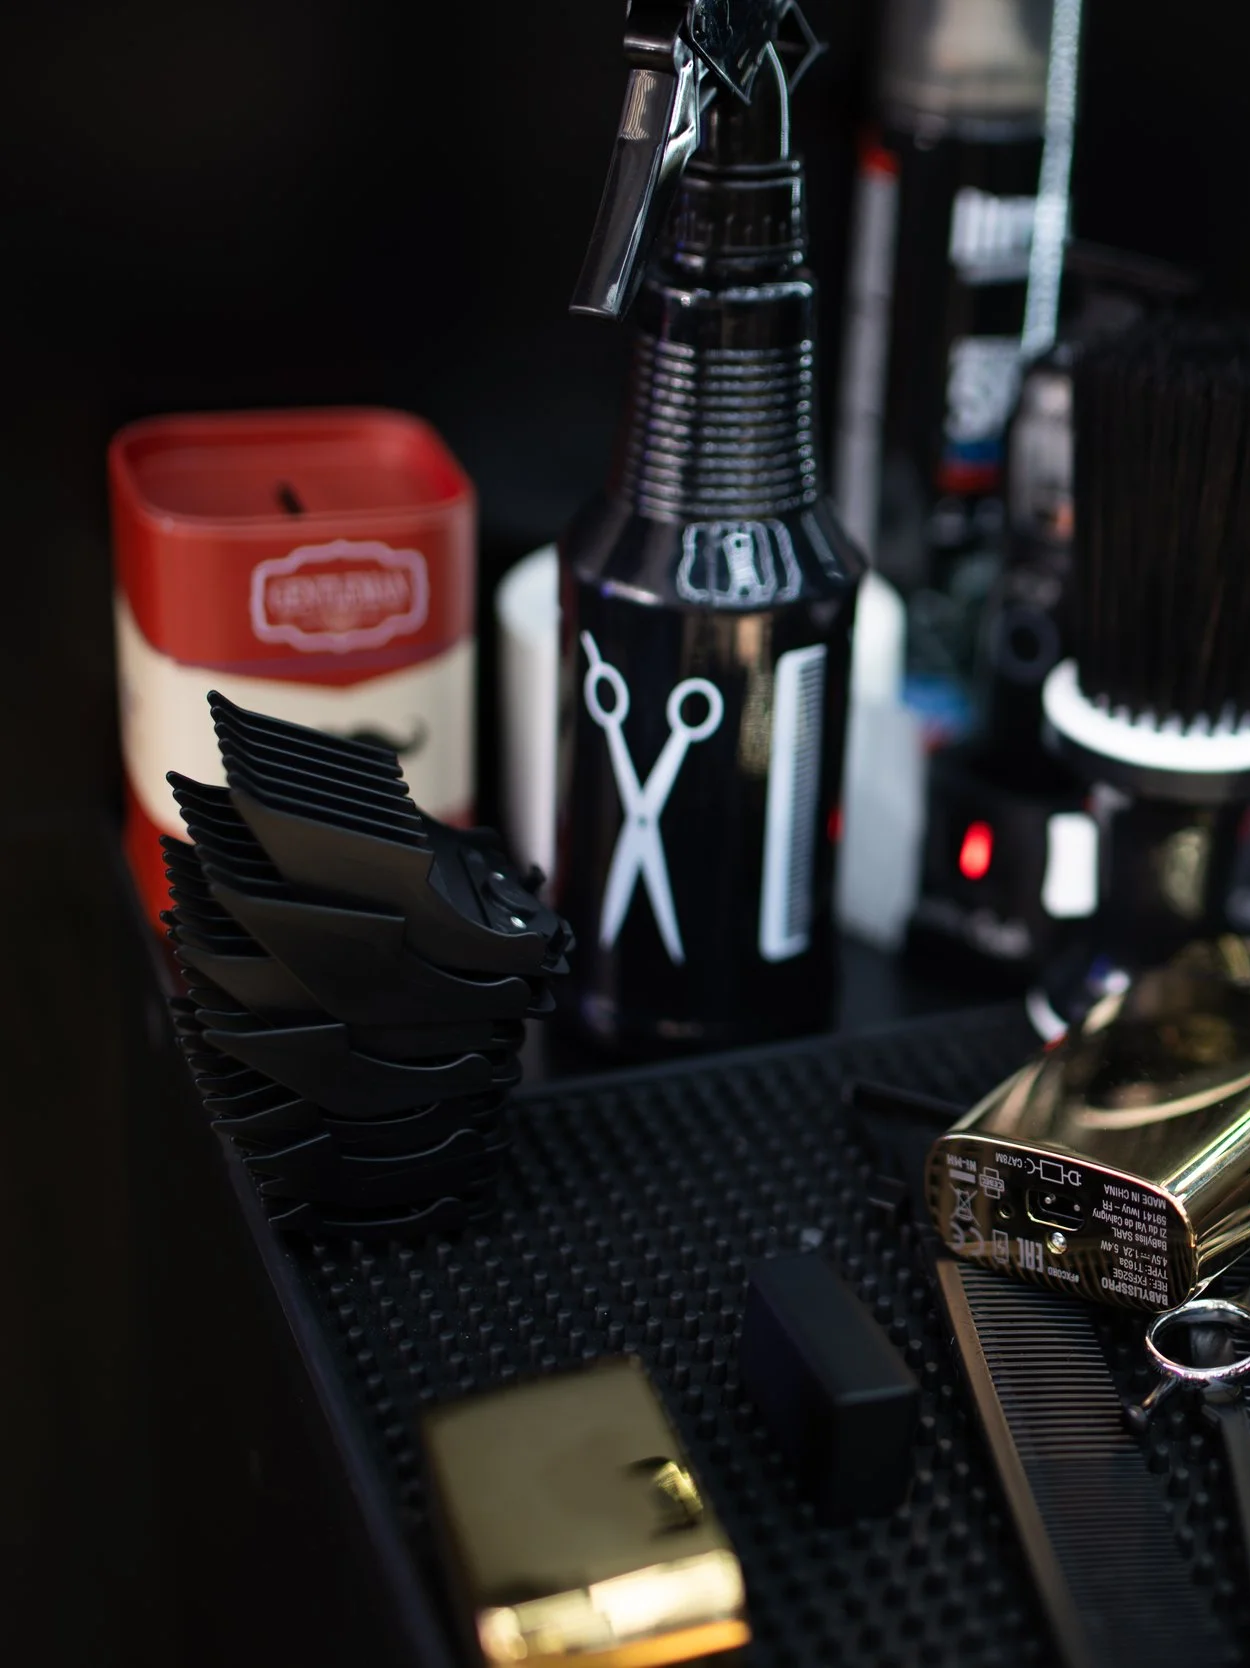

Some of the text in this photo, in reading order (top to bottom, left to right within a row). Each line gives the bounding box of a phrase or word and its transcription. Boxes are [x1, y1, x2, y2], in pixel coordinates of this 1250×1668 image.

[1104, 1184, 1166, 1209] MADE IN CHINA
[1102, 1199, 1113, 1211] FR
[1092, 1207, 1123, 1226] Calvigny
[1124, 1218, 1134, 1228] de
[1143, 1213, 1166, 1225] 59141
[1135, 1222, 1147, 1233] Val
[1148, 1226, 1158, 1235] du
[1101, 1240, 1119, 1253] 5.4W
[1112, 1227, 1167, 1251] BaByliss SARL
[1113, 1267, 1148, 1286] FXFS2GE
[1119, 1257, 1168, 1280] TYPE: T163a
[1101, 1277, 1168, 1306] BABYLISSPRO
